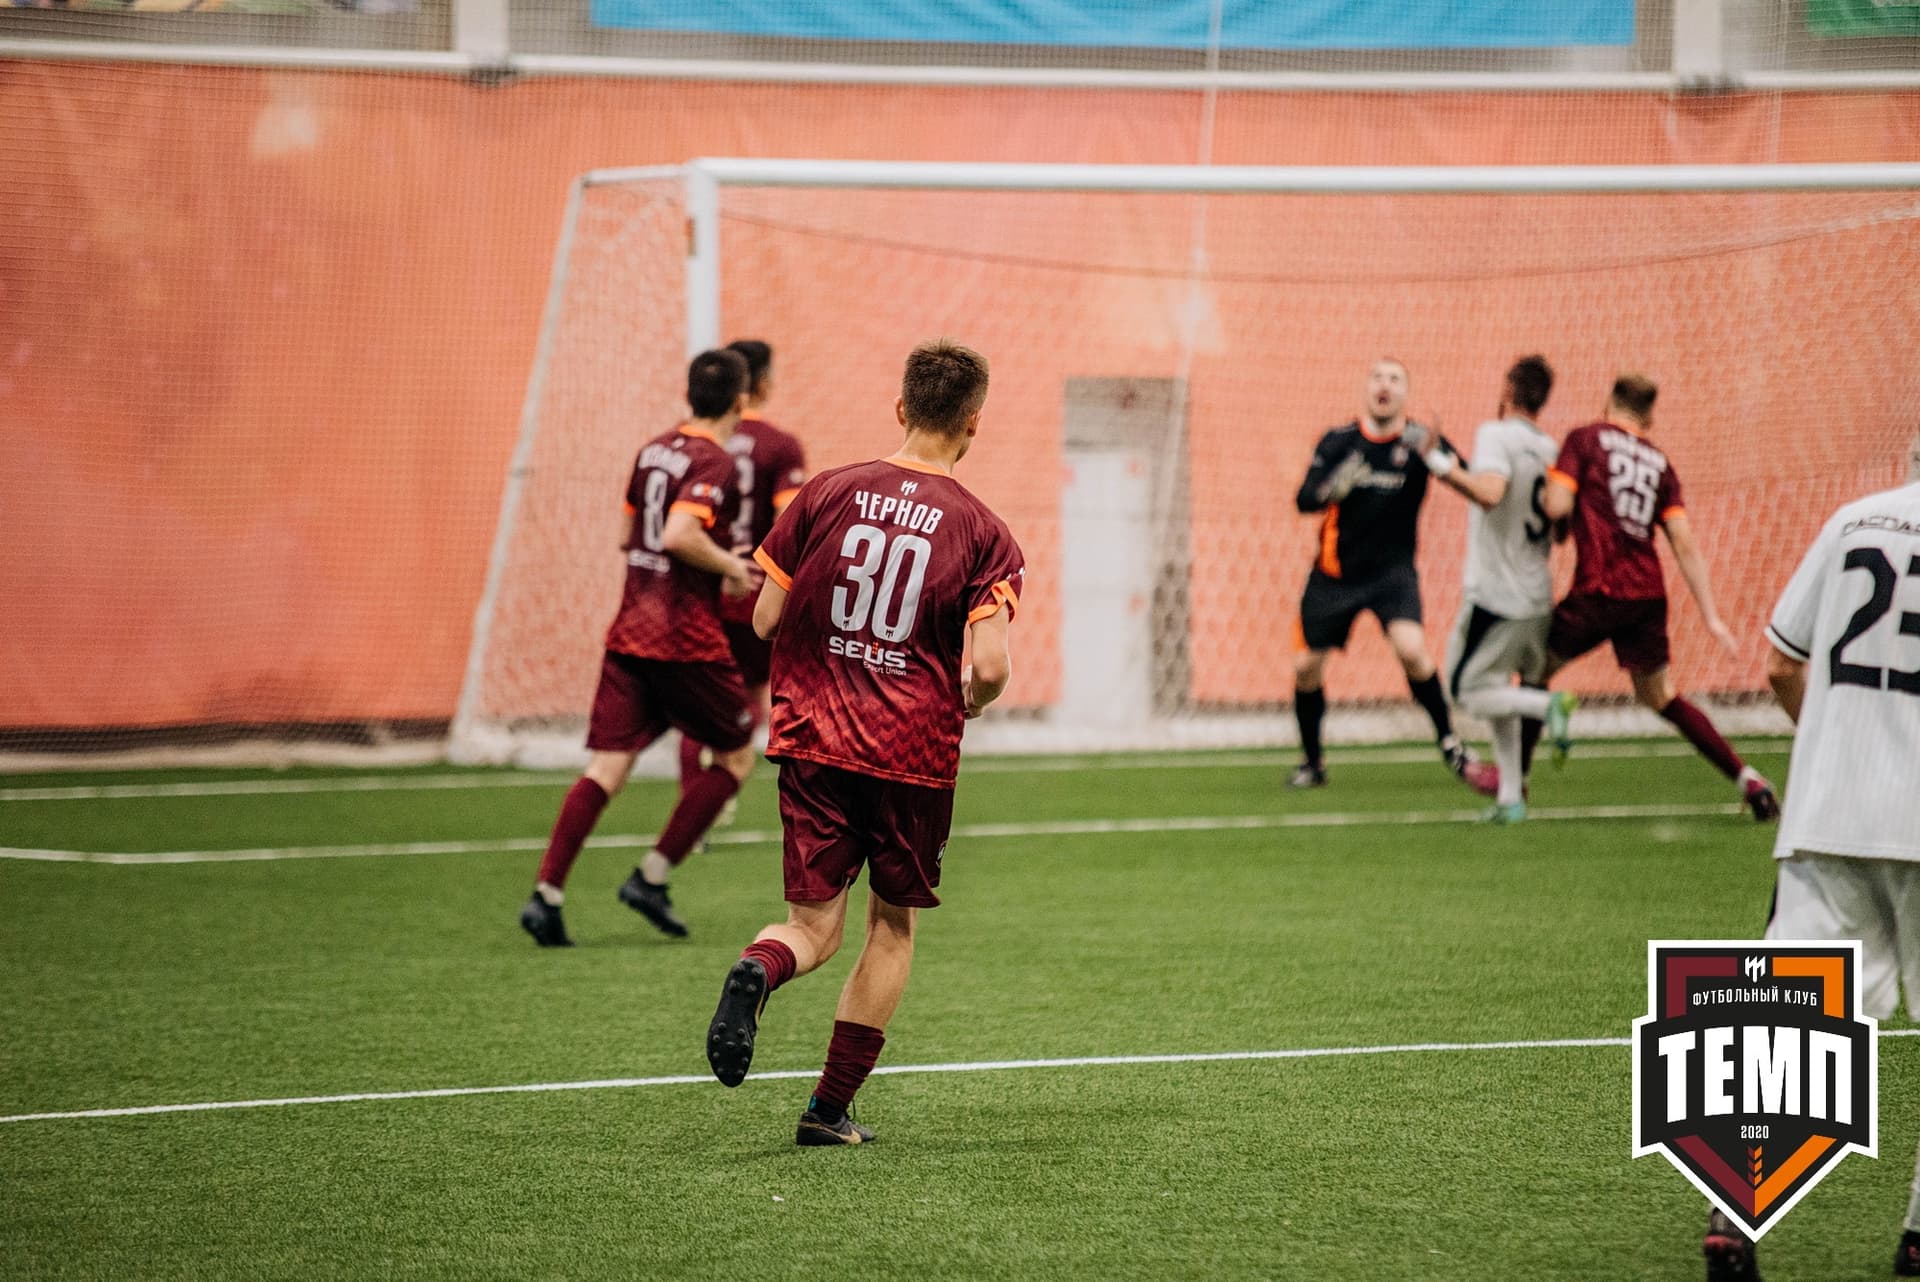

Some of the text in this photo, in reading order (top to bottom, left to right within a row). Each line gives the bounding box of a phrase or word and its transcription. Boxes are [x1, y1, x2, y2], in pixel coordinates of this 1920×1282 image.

[643, 469, 668, 552] 8
[855, 490, 943, 535] ЧЕРНОВ
[1609, 451, 1660, 526] 25
[831, 523, 931, 643] 30
[829, 635, 906, 669] SEUS
[885, 666, 907, 676] Union
